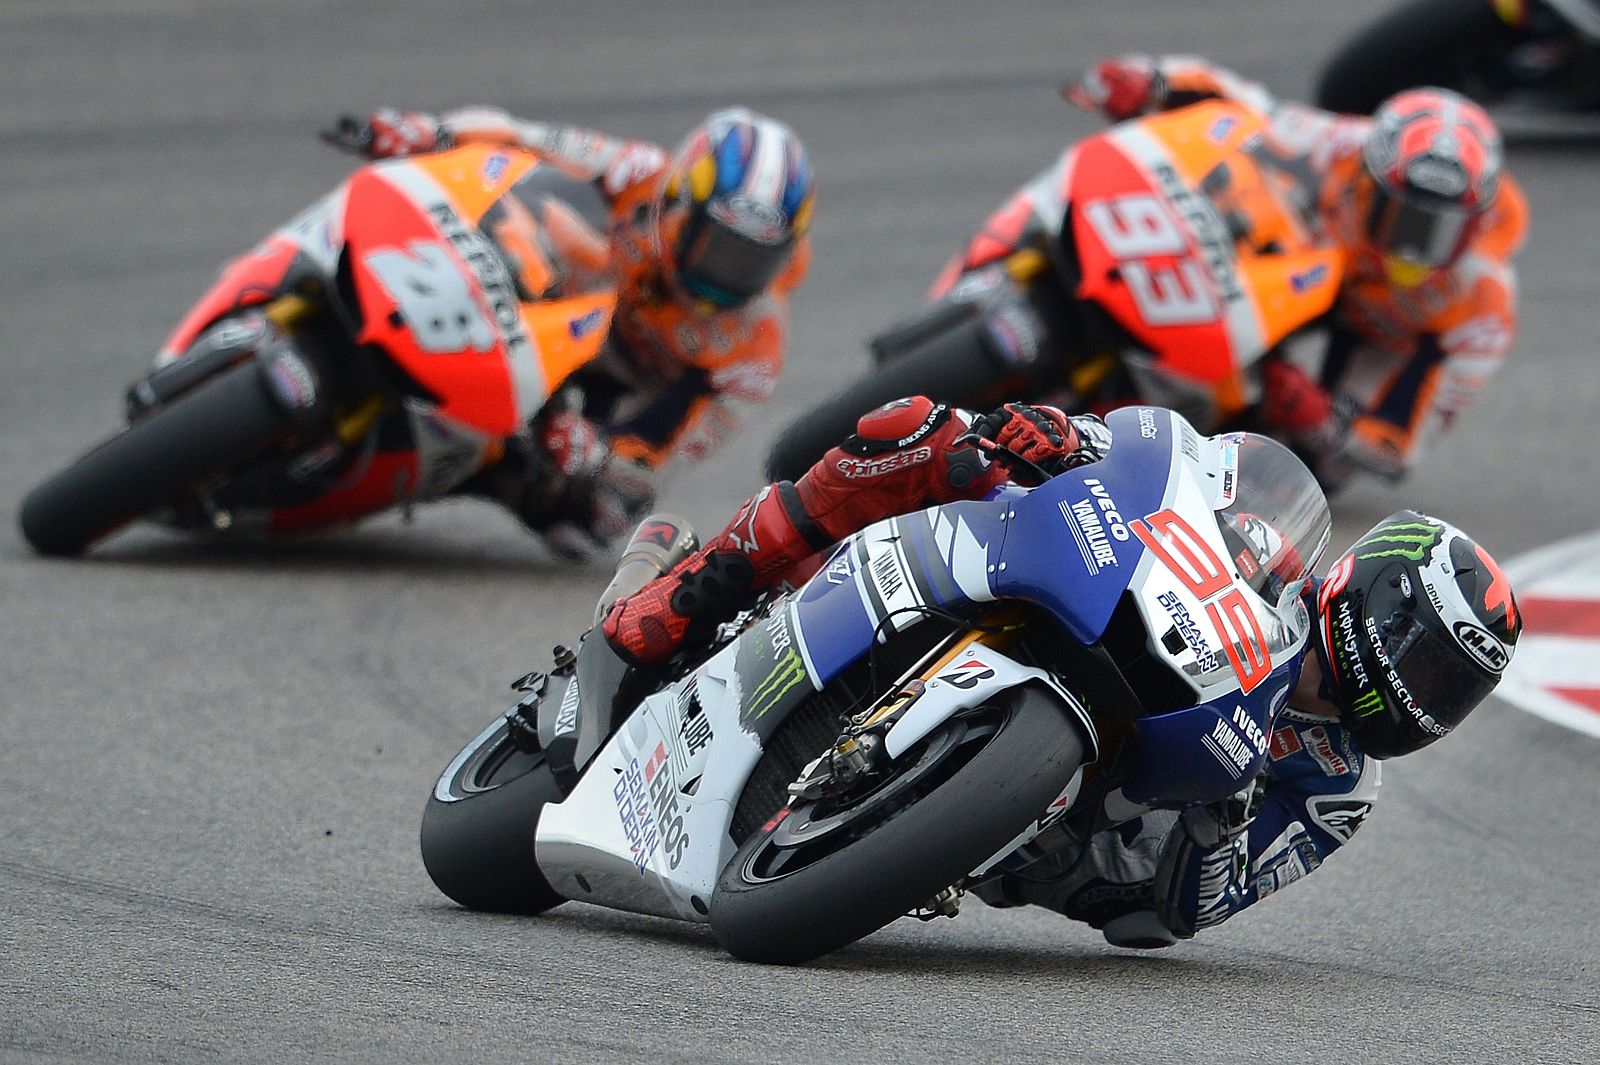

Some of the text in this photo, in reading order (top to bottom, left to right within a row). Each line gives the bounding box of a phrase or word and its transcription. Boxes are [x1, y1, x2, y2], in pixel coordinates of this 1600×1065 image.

[1084, 194, 1218, 326] 93
[837, 446, 931, 477] alpinestars
[898, 424, 930, 447] RACING
[1071, 499, 1118, 567] YAMALUBE
[1084, 479, 1129, 542] IVECO
[872, 550, 903, 601] YAMAHA
[1127, 508, 1273, 696] 99
[1425, 583, 1444, 613] RPHA
[1165, 590, 1217, 669] SEMAKIN
[1333, 620, 1352, 679] ENERGY
[1340, 601, 1369, 688] MONSTER
[1461, 629, 1507, 668] HJC
[1365, 616, 1389, 668] SECTOR
[1387, 670, 1423, 720] SECTOR
[1211, 717, 1254, 771] YAMALUBE
[1233, 705, 1266, 755] IVECO
[1317, 738, 1346, 776] YAMAHA
[625, 758, 660, 856] SEMAKIN
[649, 761, 690, 871] ENEOS
[1195, 843, 1233, 928] YAMAH
